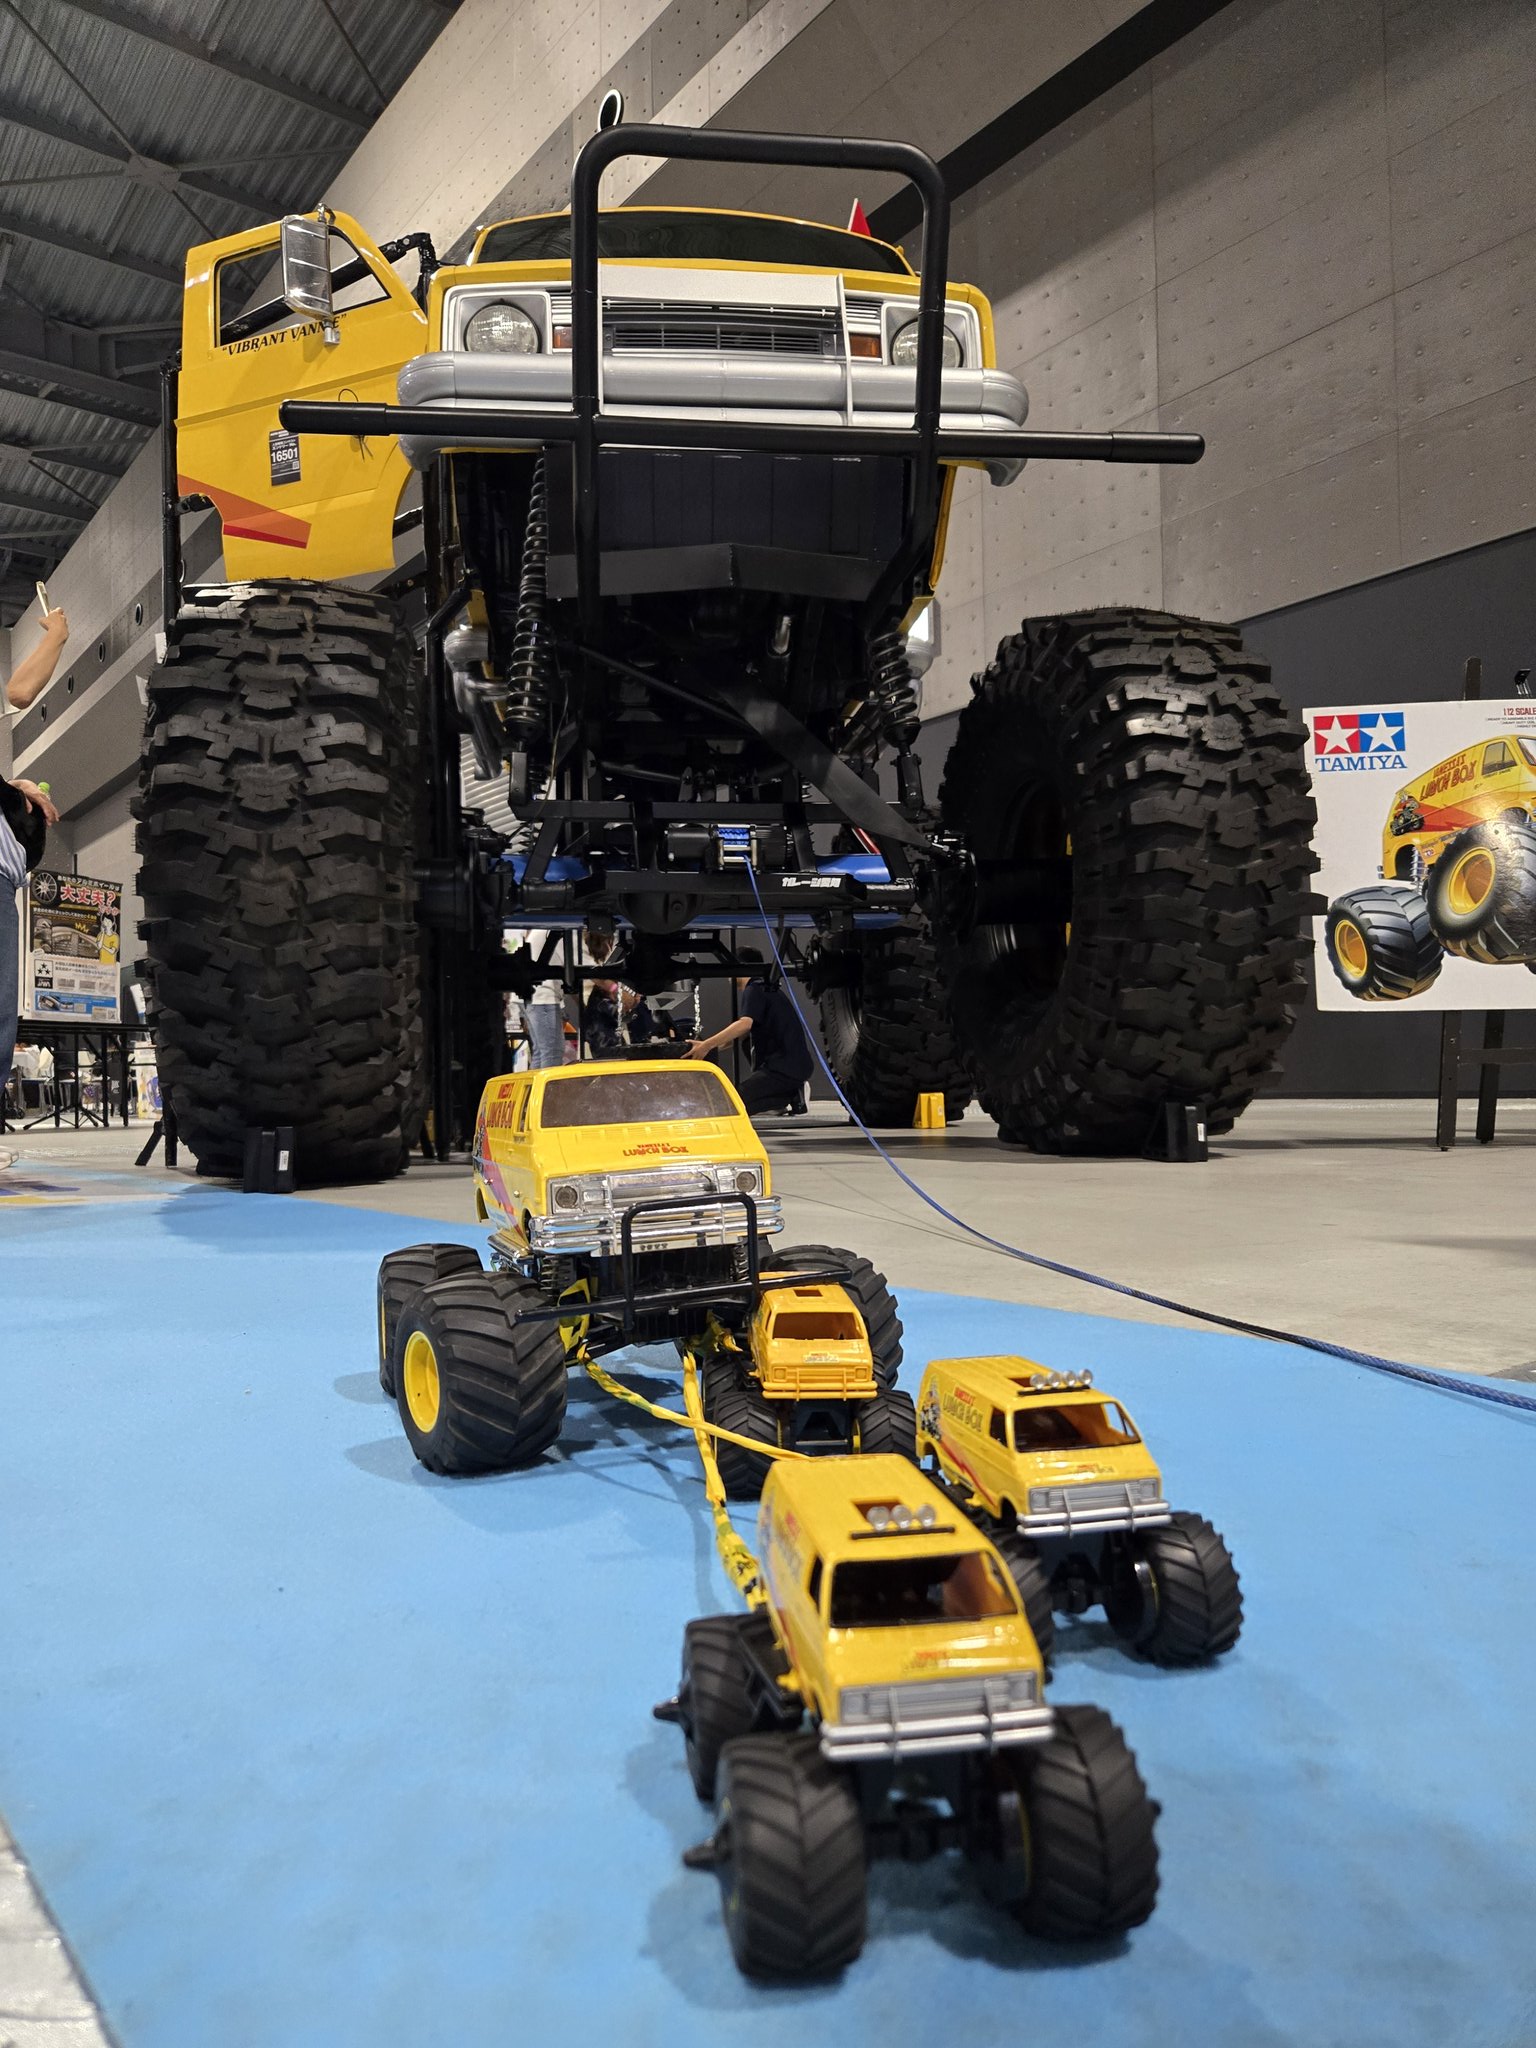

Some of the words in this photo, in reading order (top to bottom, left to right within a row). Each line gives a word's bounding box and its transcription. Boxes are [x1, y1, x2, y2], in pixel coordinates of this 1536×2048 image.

[270, 447, 298, 463] 16501
[1315, 754, 1408, 772] TAMIYA
[661, 1146, 689, 1154] BOX
